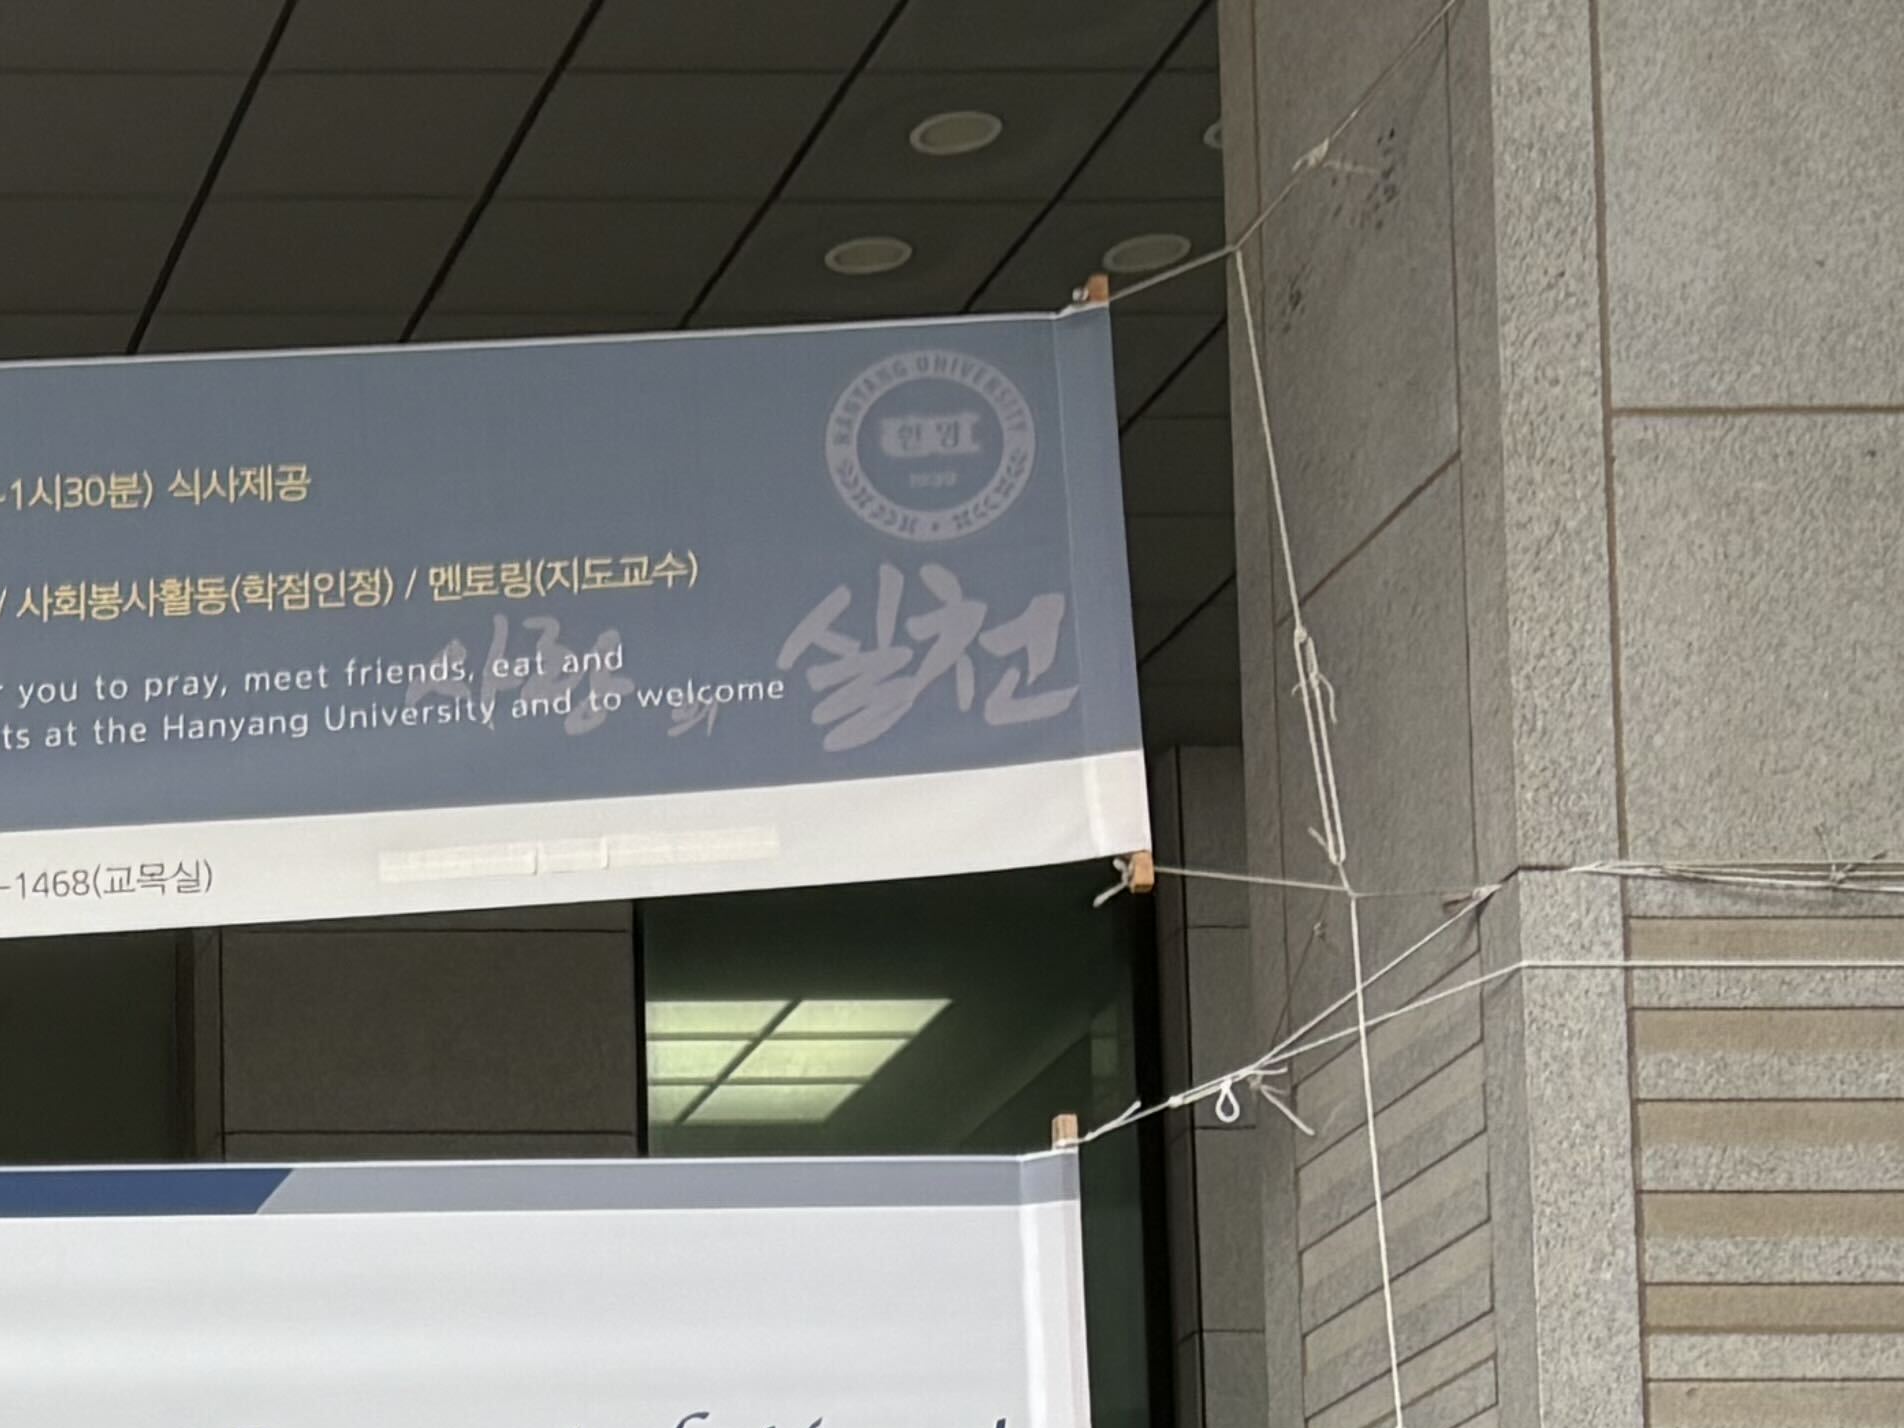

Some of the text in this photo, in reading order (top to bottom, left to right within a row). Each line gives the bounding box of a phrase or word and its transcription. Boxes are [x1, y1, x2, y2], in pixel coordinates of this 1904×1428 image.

[168, 464, 311, 504] 식사제공
[16, 568, 393, 622] 사회봉사활동(학점인정)
[429, 551, 697, 601] 멘토링(지도교수)
[18, 680, 78, 714] you
[94, 675, 128, 702] to
[144, 668, 228, 702] pray,
[244, 664, 328, 692] meet
[344, 654, 476, 686] friends,
[492, 652, 545, 678] eat
[562, 645, 623, 674] and
[46, 721, 76, 747] at
[94, 714, 147, 744] the
[162, 708, 309, 745] Hanyang
[324, 700, 494, 734] University
[511, 693, 572, 720] and
[589, 690, 622, 716] to
[638, 675, 785, 710] welcome
